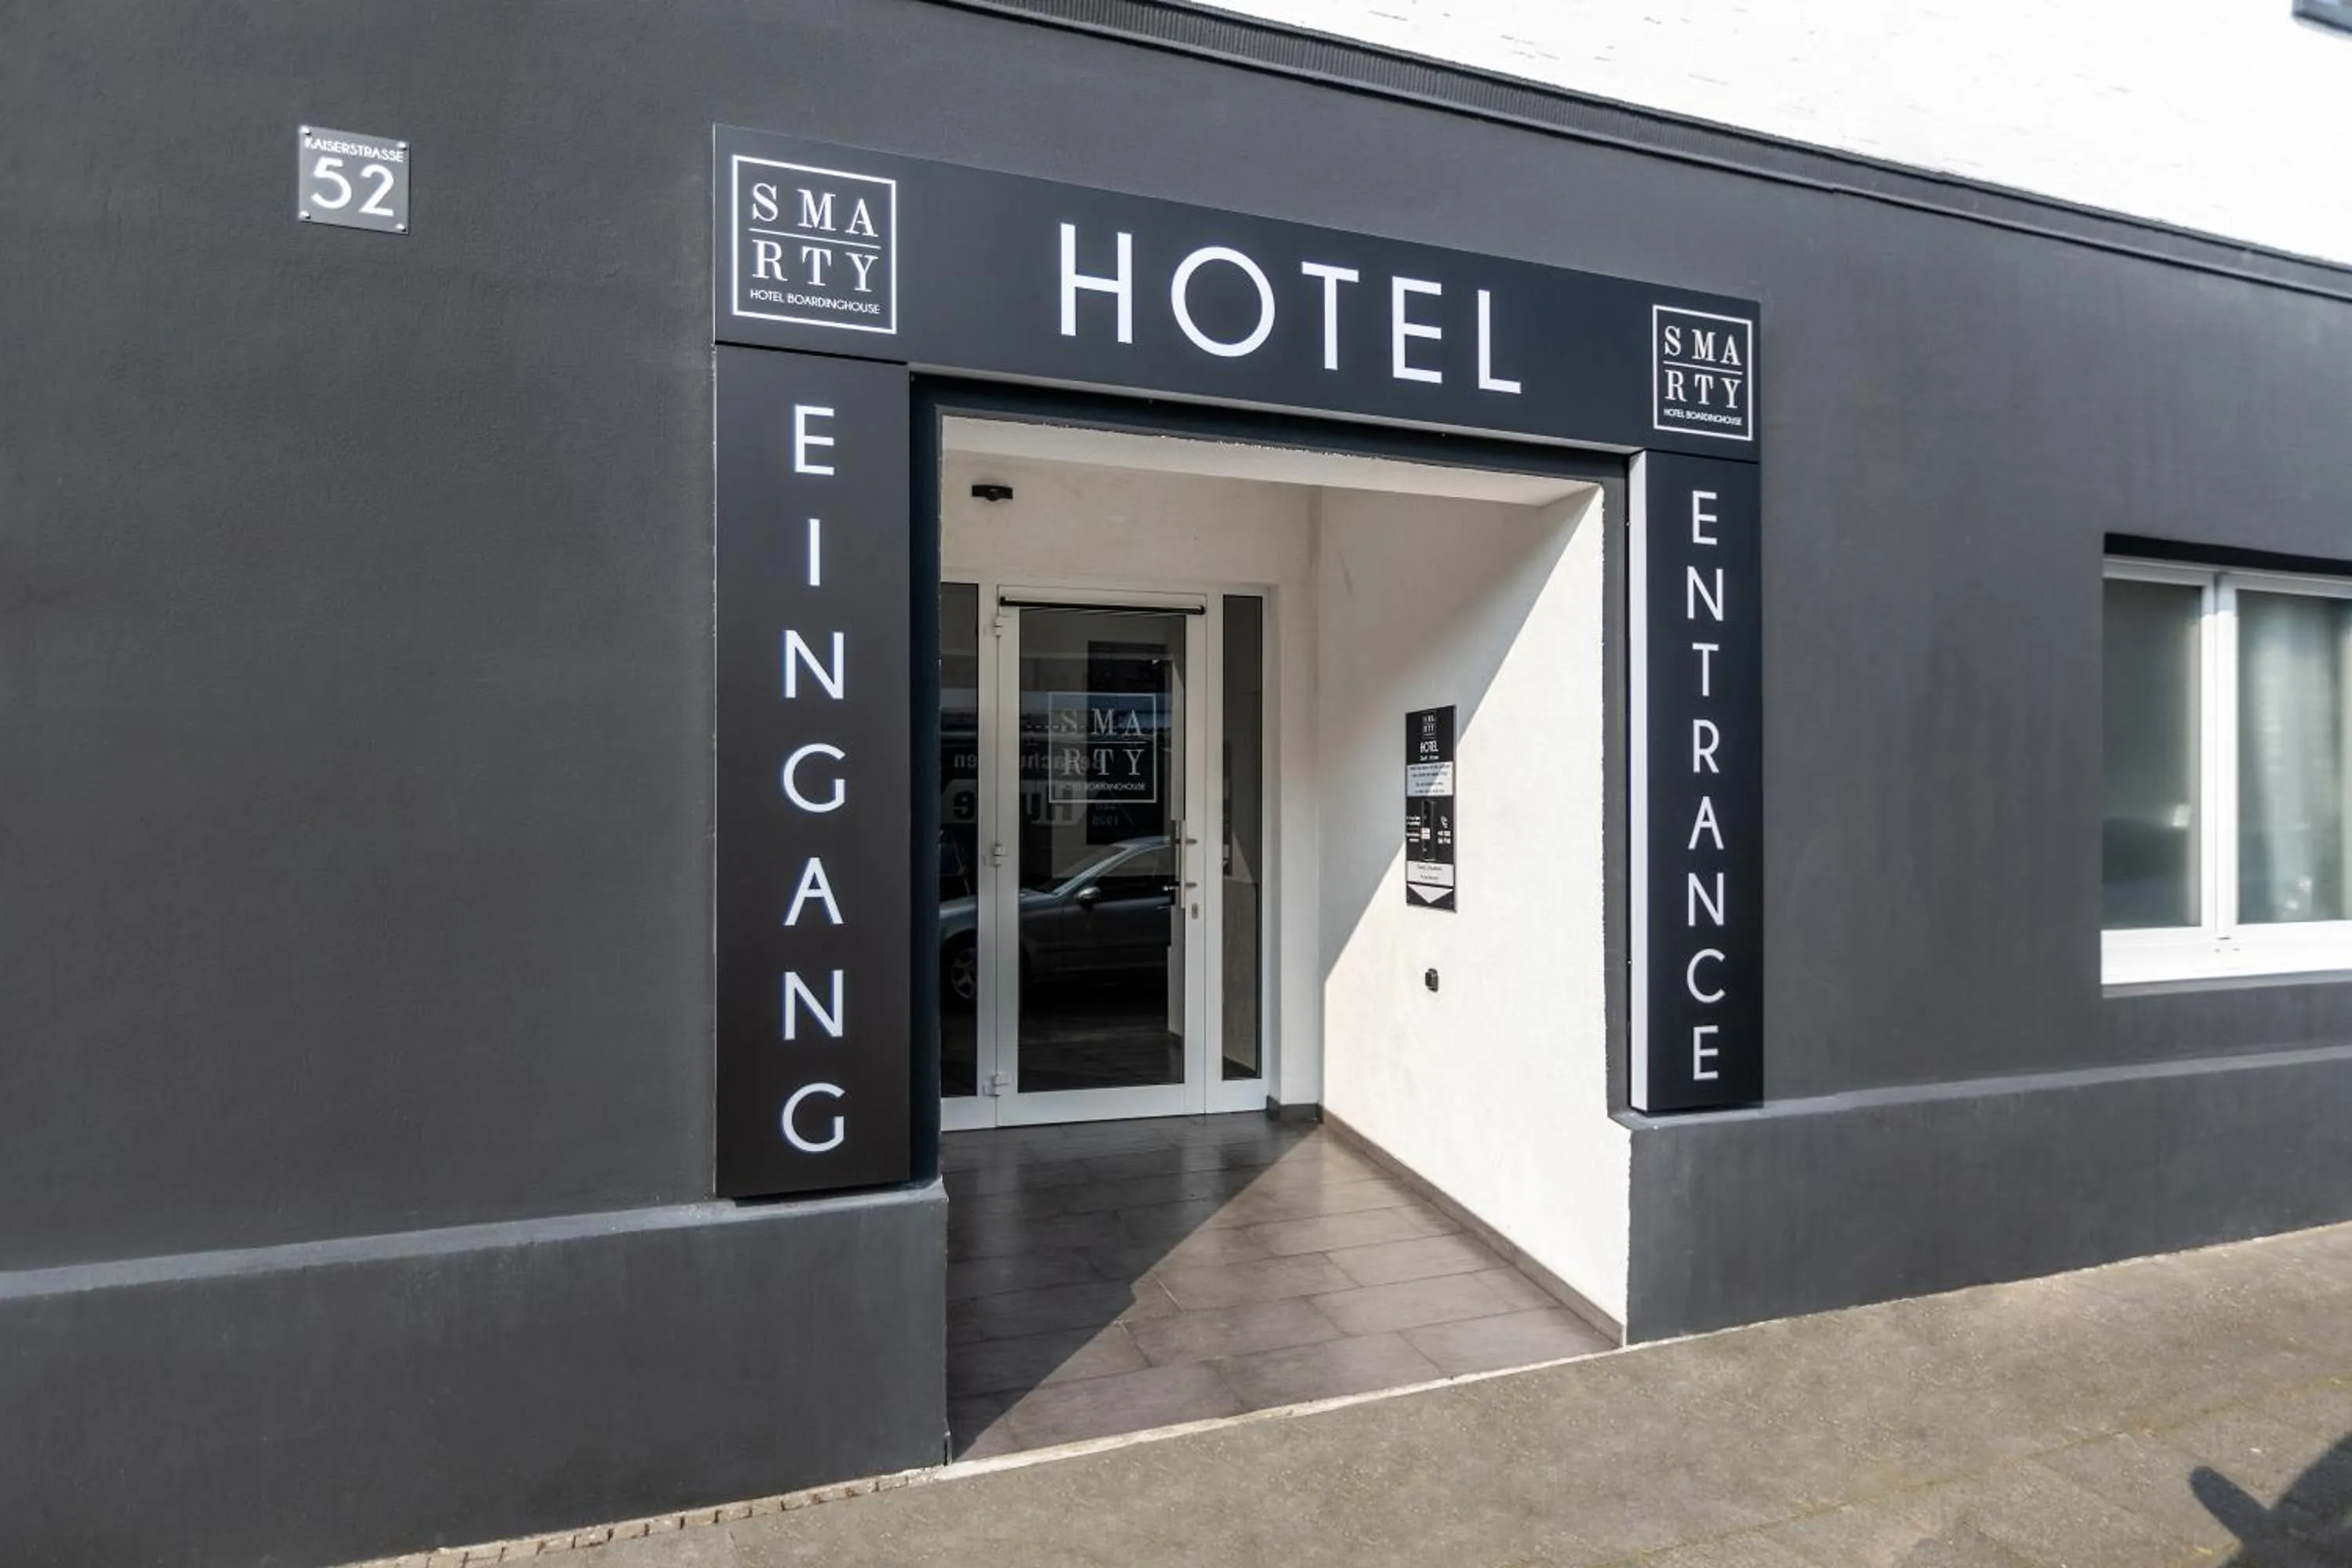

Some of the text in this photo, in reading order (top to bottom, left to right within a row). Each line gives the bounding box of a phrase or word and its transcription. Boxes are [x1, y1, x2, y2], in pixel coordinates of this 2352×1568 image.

[305, 137, 405, 162] KAISERSTRASSE
[311, 157, 394, 216] 52
[752, 182, 879, 238] SMA
[752, 238, 879, 292] RTY
[750, 288, 880, 314] HOTEL BOARDINGHOUSE
[1061, 223, 1522, 394] HOTEL
[1664, 325, 1742, 366] SMA
[1664, 369, 1742, 409] RTY
[1664, 408, 1685, 419] HOTEL
[782, 404, 845, 1152] EINGANG
[1686, 490, 1726, 1080] ENTRANCE
